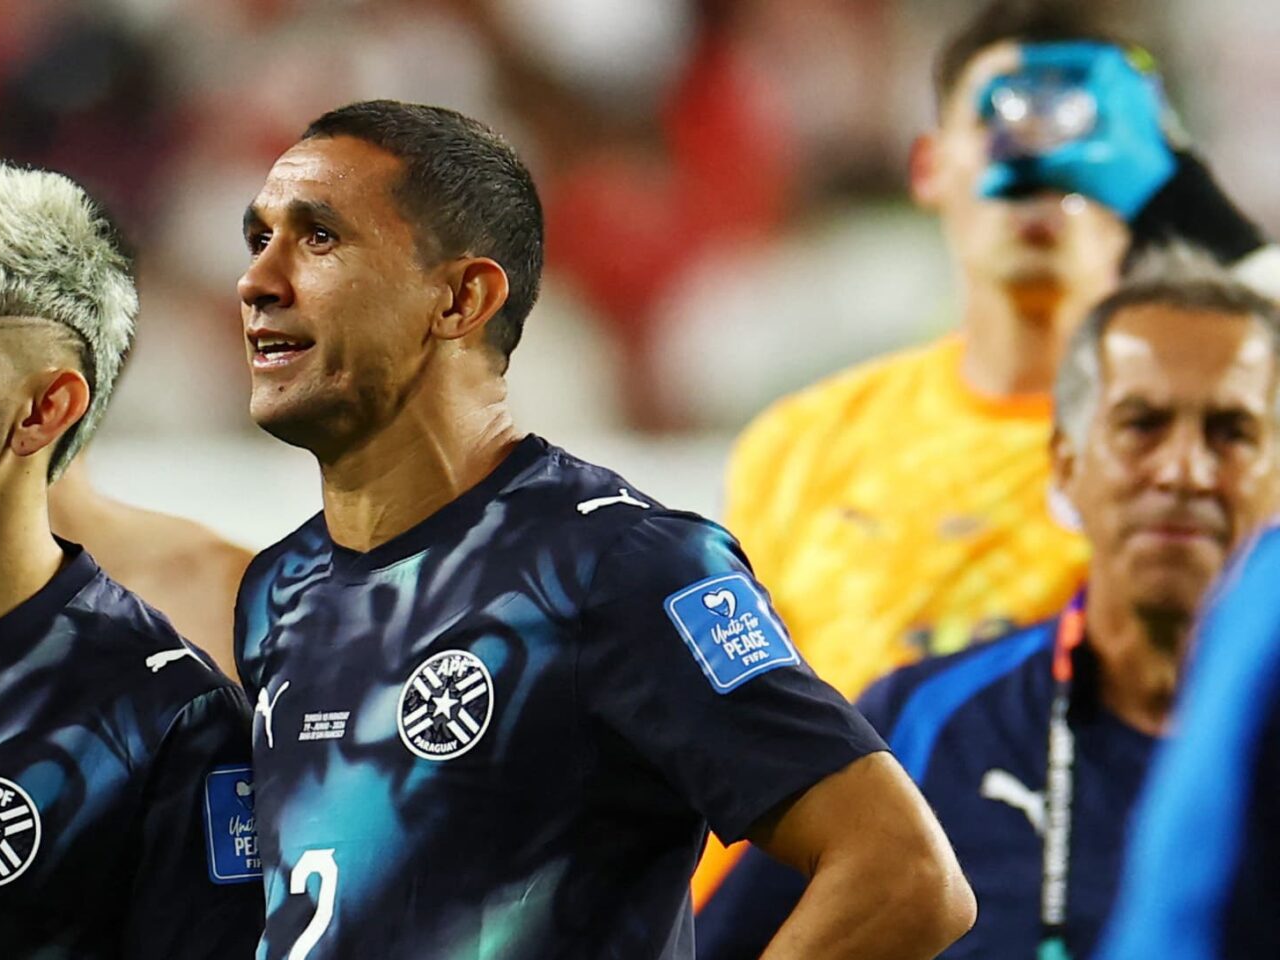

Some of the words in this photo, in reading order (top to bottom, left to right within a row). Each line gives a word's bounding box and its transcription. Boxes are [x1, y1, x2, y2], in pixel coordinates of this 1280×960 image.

[711, 617, 745, 646] Unite
[740, 612, 759, 632] For
[723, 629, 770, 660] PEACE
[436, 656, 473, 678] APF
[742, 650, 770, 666] FIFA
[413, 735, 458, 754] PARAGUAY
